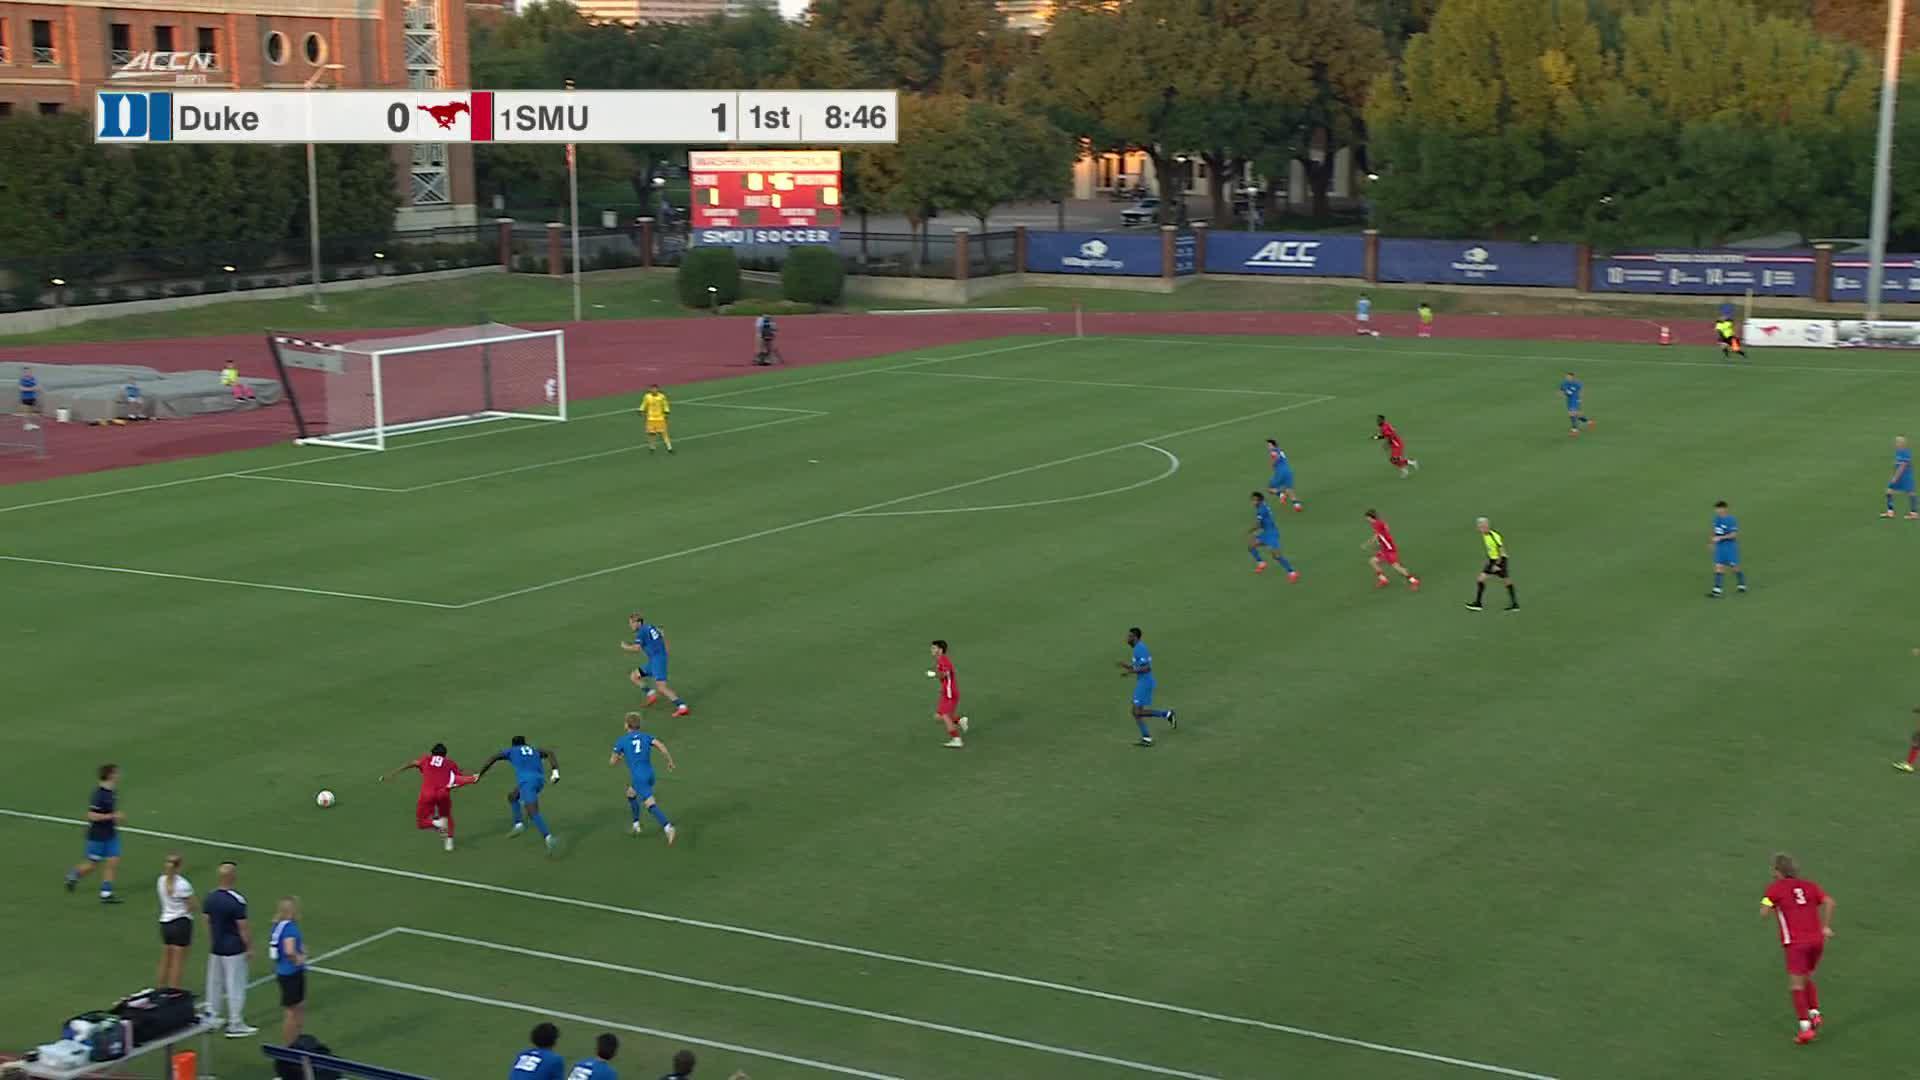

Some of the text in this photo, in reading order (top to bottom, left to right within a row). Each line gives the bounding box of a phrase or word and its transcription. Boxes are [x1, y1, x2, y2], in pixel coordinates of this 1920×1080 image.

[703, 230, 831, 243] SMU SOCCER
[1251, 241, 1320, 261] ACC
[631, 739, 641, 753] 7
[430, 755, 444, 768] 19
[1792, 887, 1807, 905] 3
